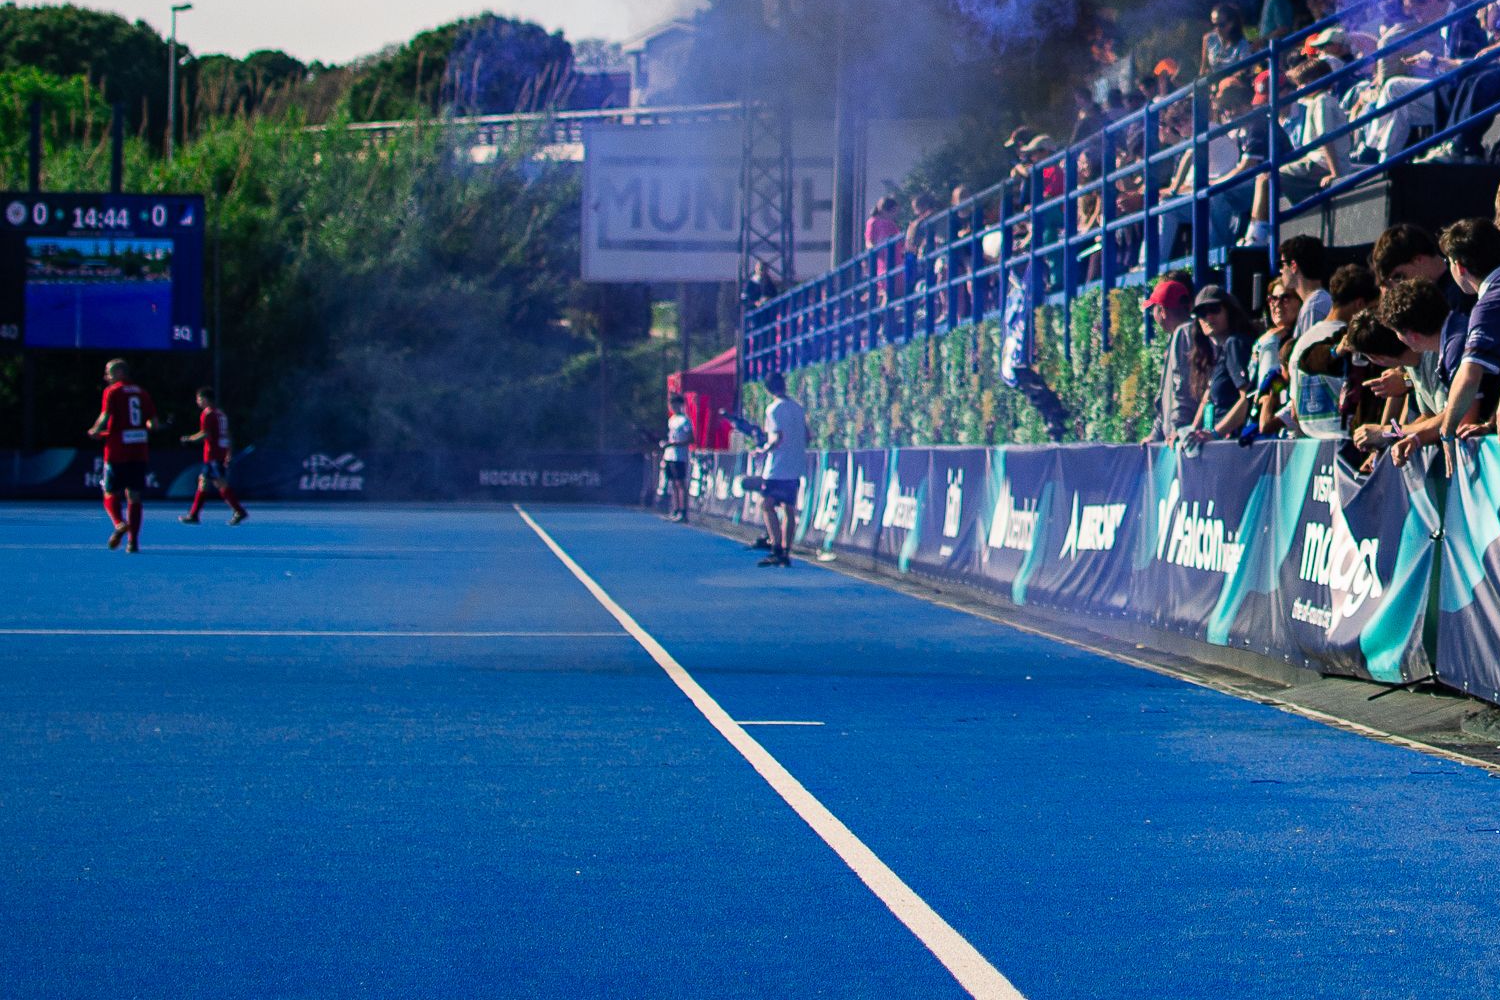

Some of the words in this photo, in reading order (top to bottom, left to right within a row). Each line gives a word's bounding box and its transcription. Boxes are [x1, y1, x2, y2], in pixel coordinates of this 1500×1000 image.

[33, 202, 48, 225] 0
[73, 208, 129, 228] 14:44
[151, 204, 167, 227] 0
[598, 176, 836, 234] MUNH
[127, 396, 141, 427] 6
[479, 470, 538, 486] HOCKEY
